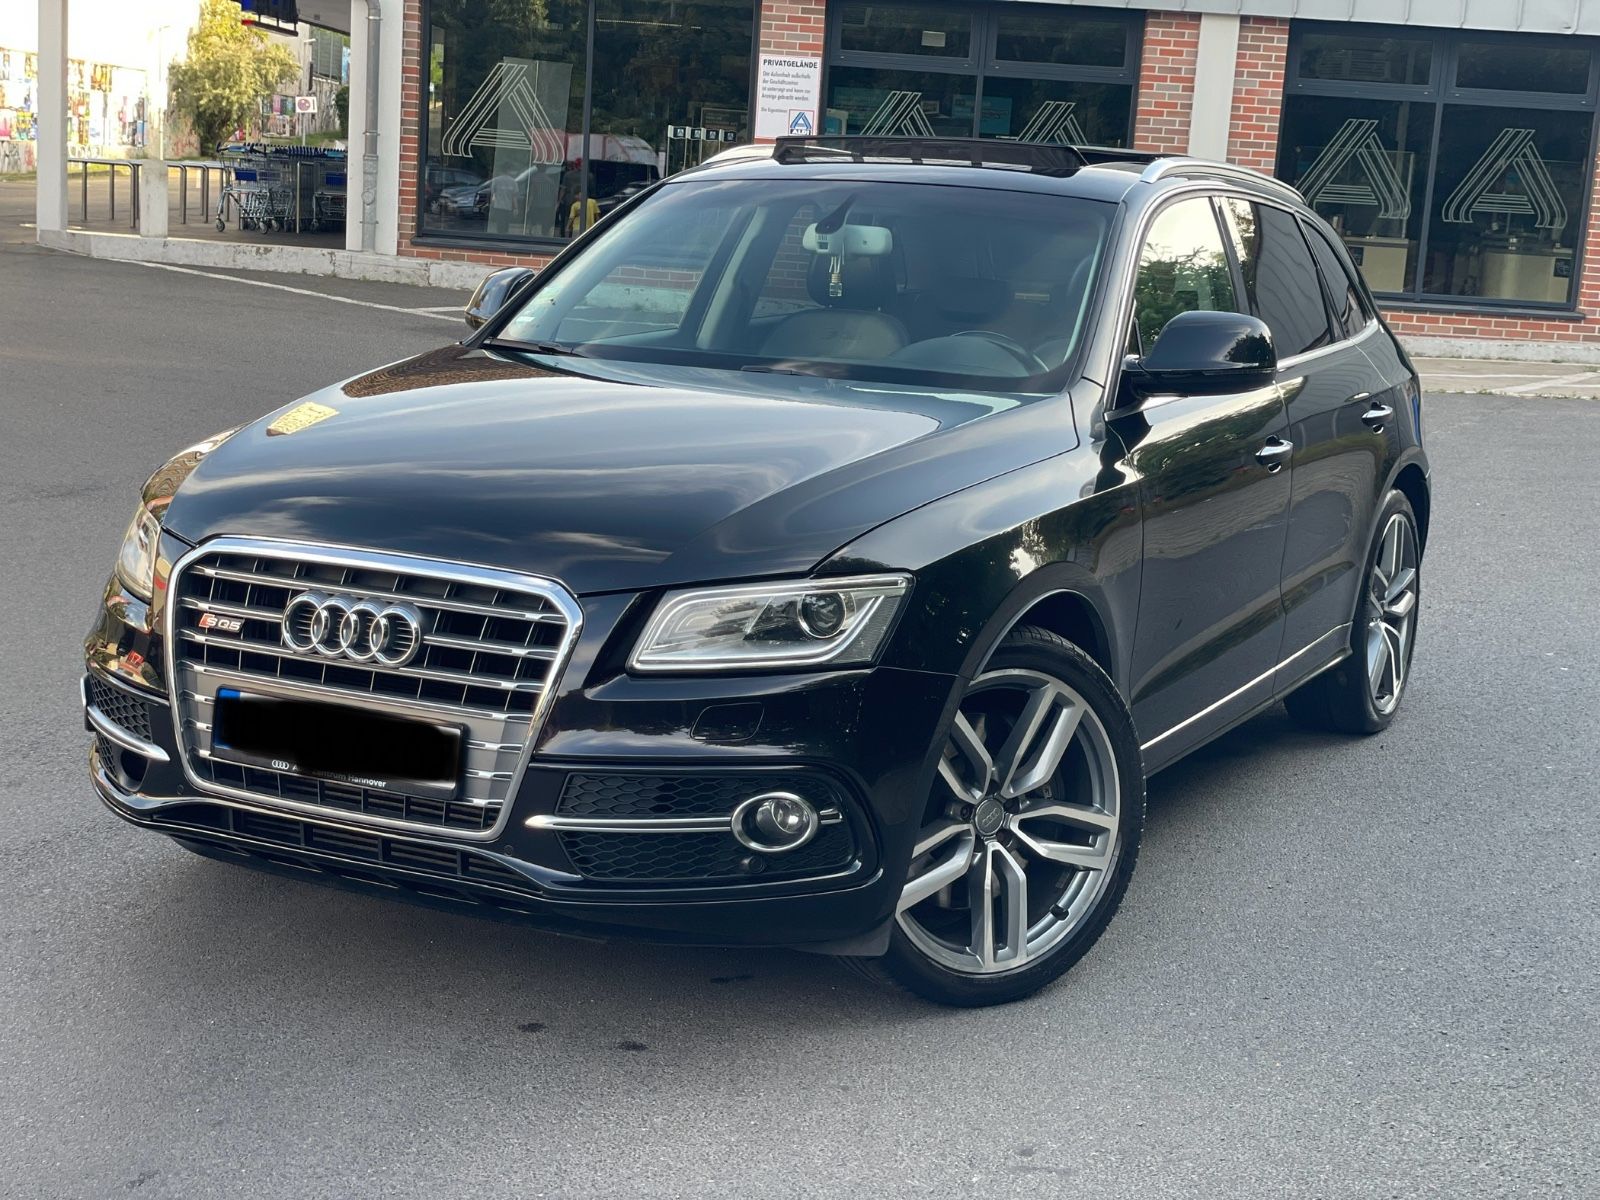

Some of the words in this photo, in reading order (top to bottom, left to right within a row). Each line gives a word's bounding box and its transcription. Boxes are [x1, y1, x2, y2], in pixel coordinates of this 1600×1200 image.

[763, 59, 818, 69] PRIVATGELÄNDE
[202, 614, 242, 630] SQ5
[348, 775, 386, 788] Hannover
